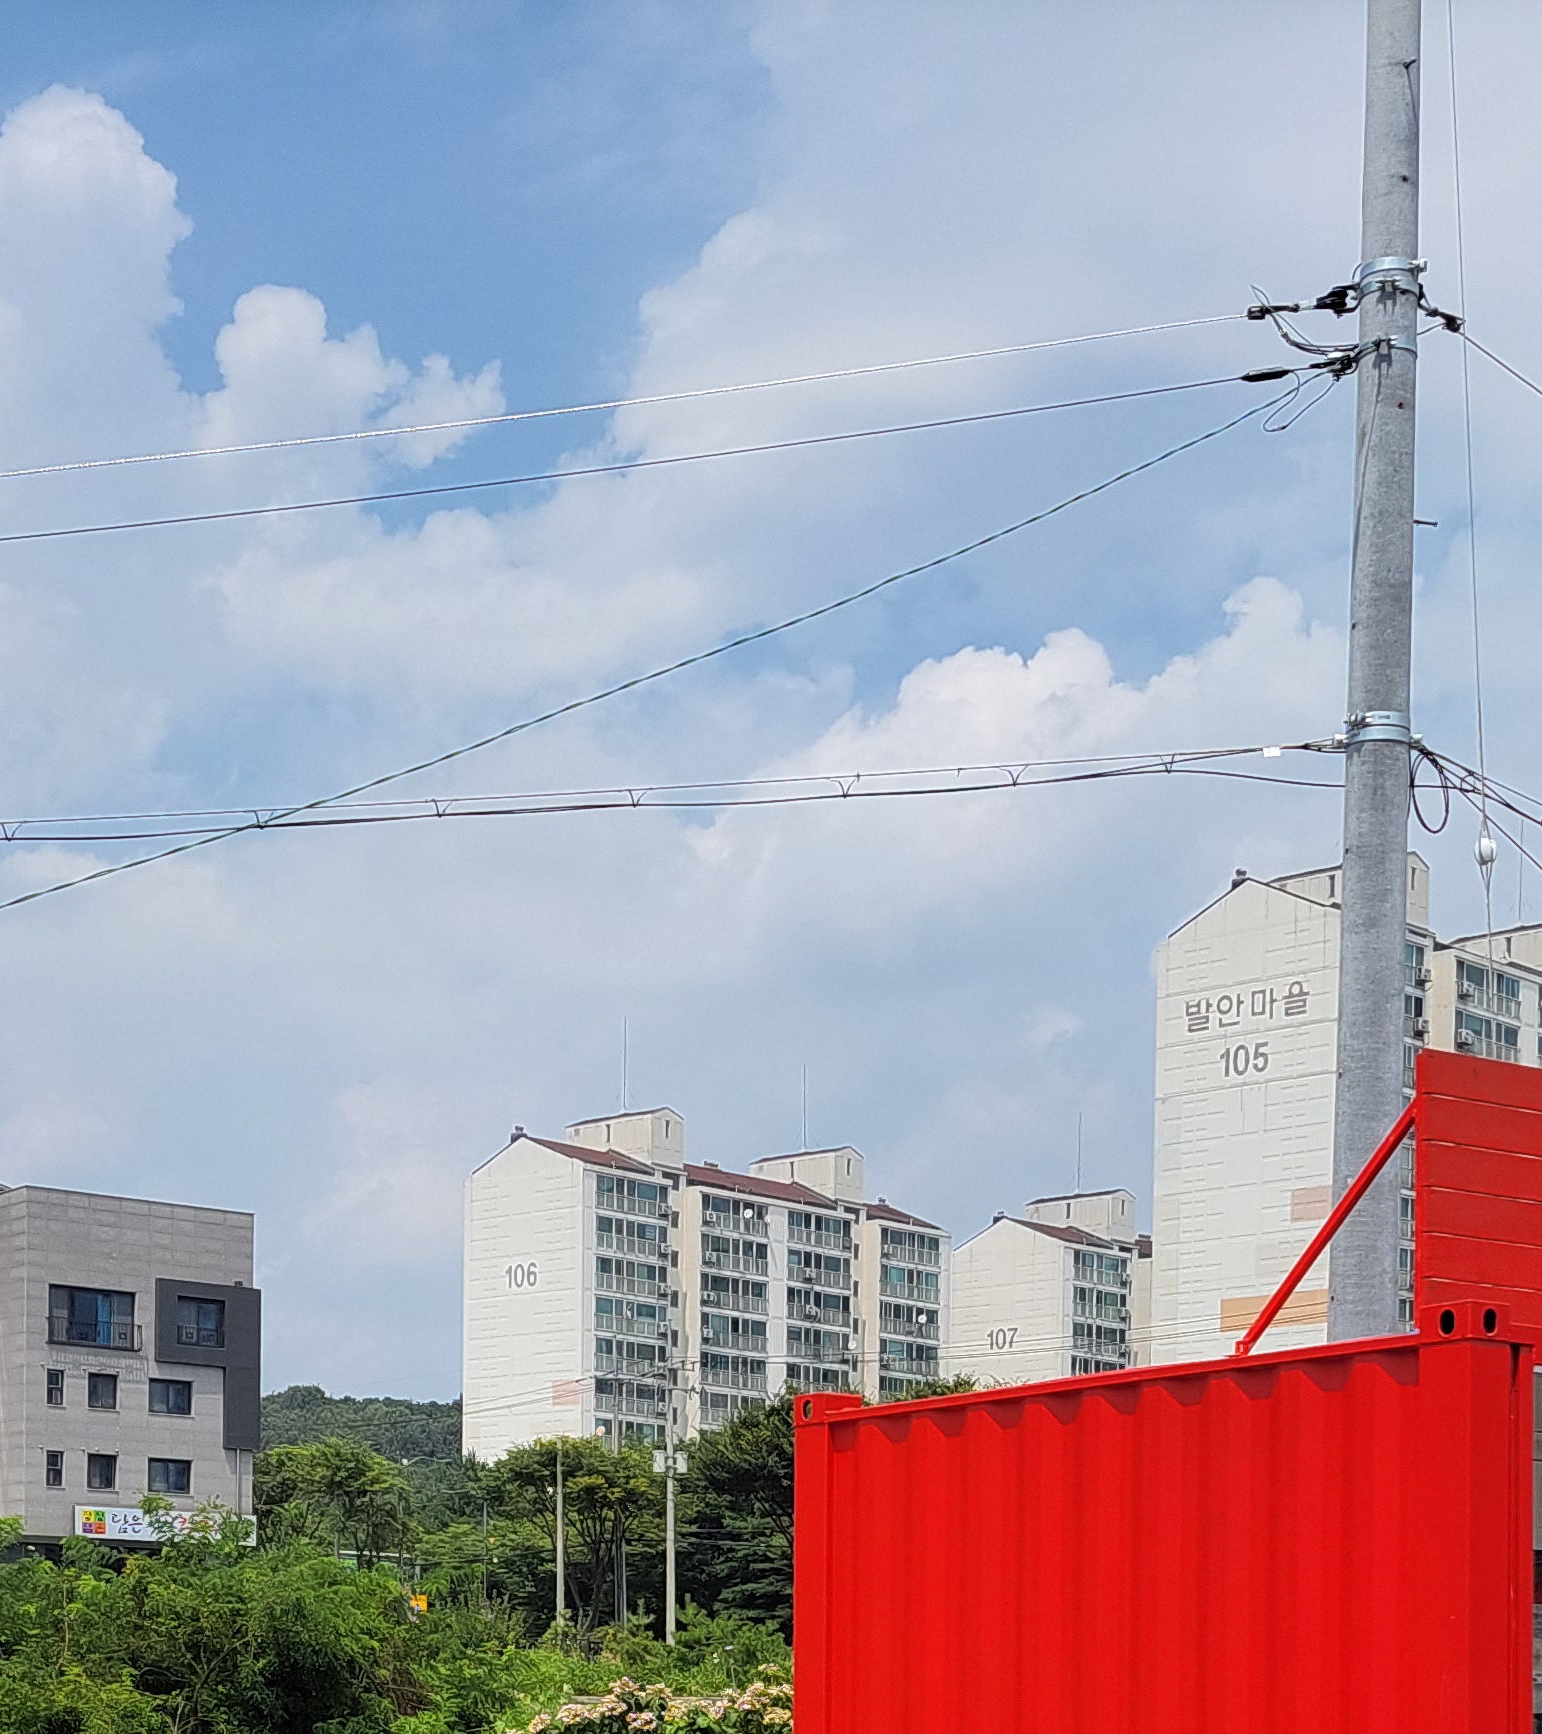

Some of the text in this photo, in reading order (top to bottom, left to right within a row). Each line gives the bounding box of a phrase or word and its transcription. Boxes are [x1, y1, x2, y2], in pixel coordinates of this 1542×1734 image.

[1219, 1041, 1269, 1077] 105
[505, 1261, 538, 1289] 106
[986, 1327, 1019, 1351] 107
